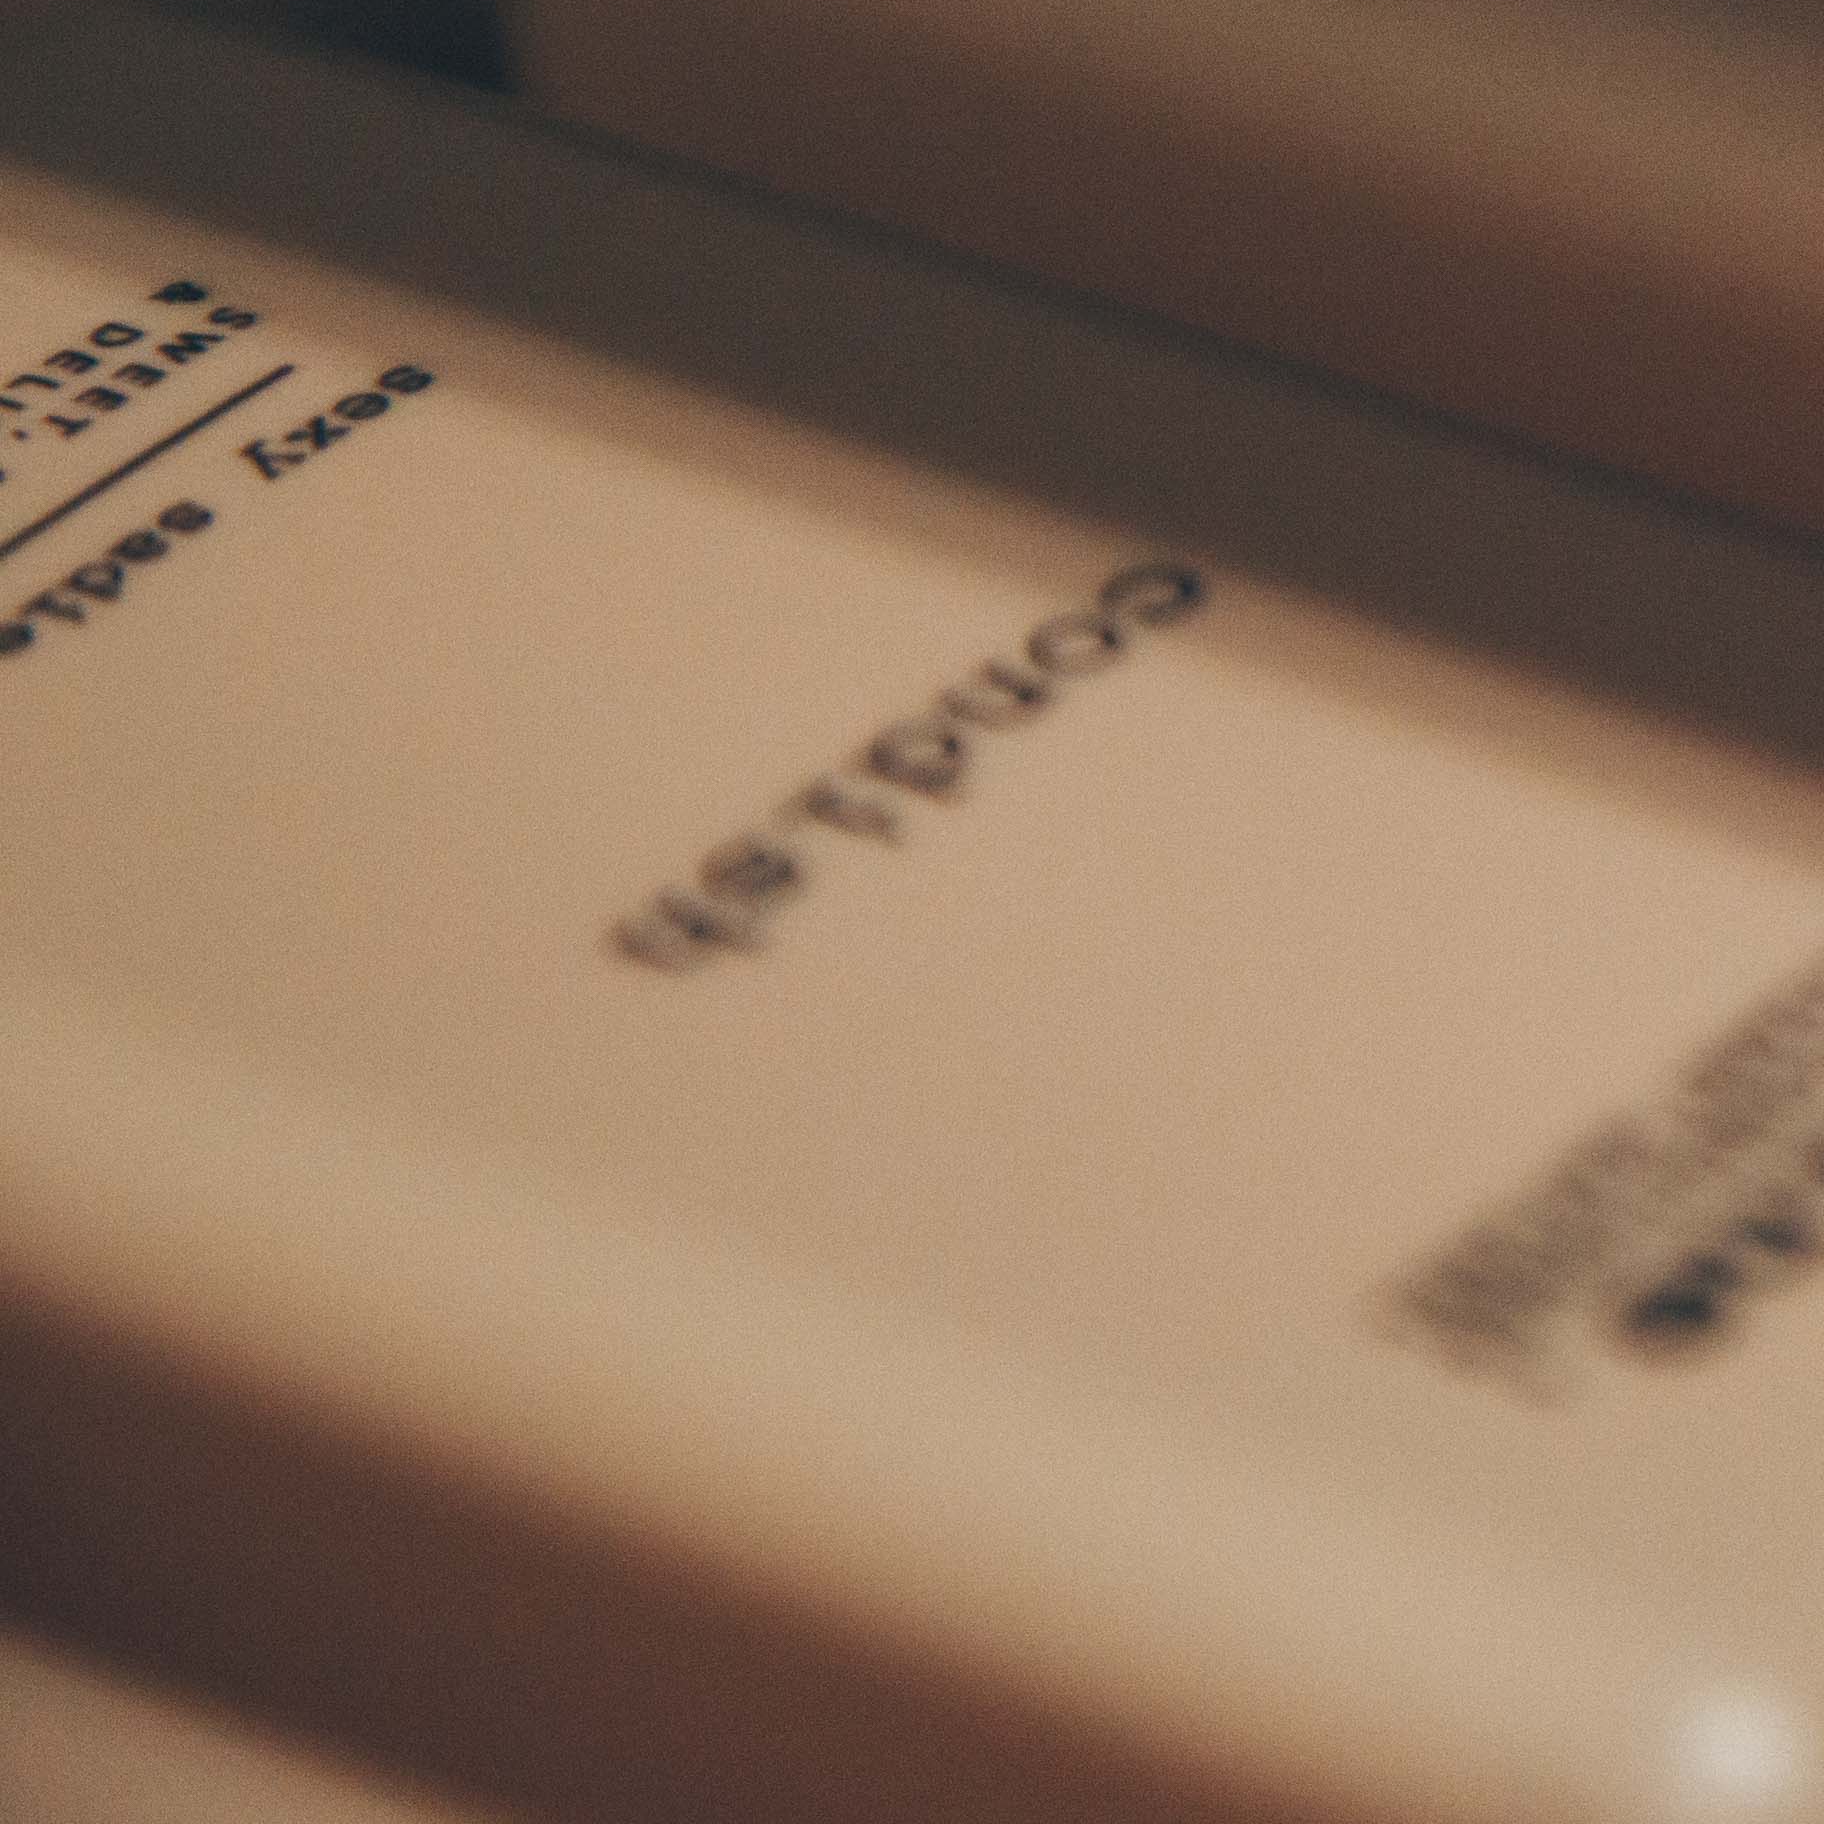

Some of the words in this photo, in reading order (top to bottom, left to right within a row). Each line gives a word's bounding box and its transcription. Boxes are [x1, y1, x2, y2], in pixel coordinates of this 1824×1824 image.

[238, 363, 437, 483] sexy
[0, 498, 215, 658] sadie
[608, 564, 1210, 976] condish
